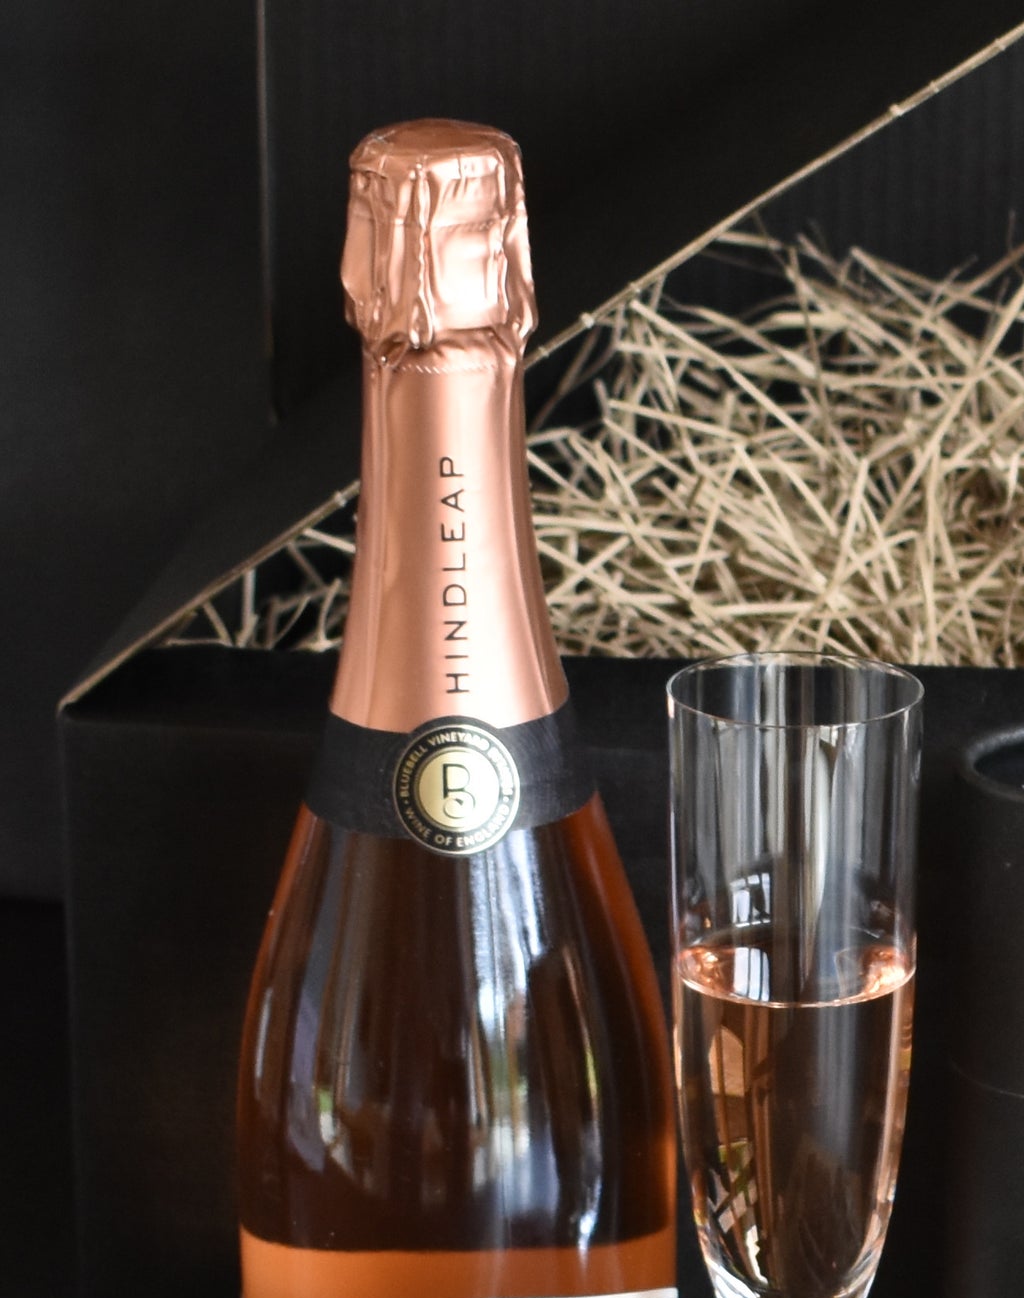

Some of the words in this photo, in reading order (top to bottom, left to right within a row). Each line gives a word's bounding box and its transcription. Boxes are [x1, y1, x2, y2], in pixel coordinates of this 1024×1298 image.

[440, 455, 469, 694] HINDLEAP
[400, 745, 428, 798] BLUEBELL
[405, 808, 432, 838] WINE
[434, 834, 453, 846] OF
[456, 804, 510, 847] ENGLAND
